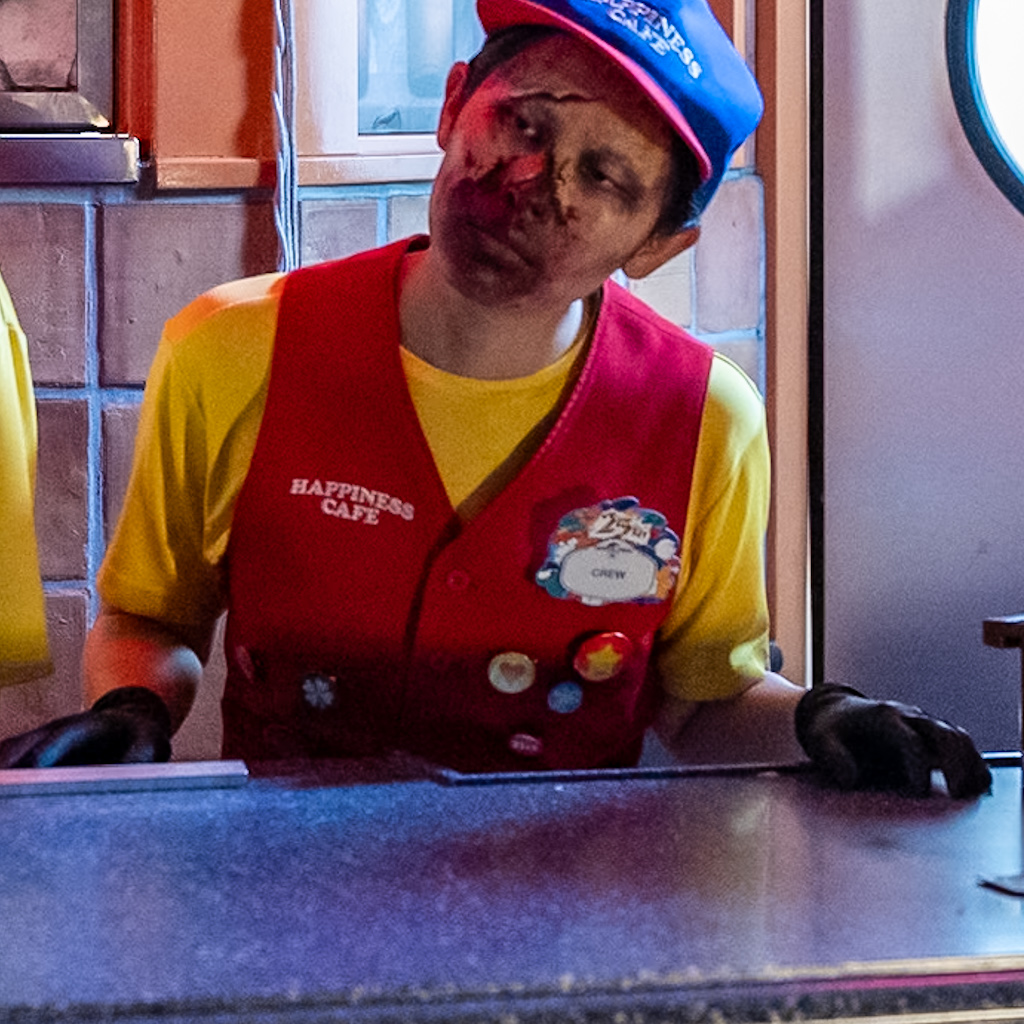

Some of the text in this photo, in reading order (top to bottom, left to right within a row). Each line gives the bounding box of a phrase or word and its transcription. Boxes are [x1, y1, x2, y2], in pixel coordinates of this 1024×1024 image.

[290, 478, 414, 521] HAPPINESS
[321, 498, 379, 525] CAFE
[591, 568, 626, 580] CREW
